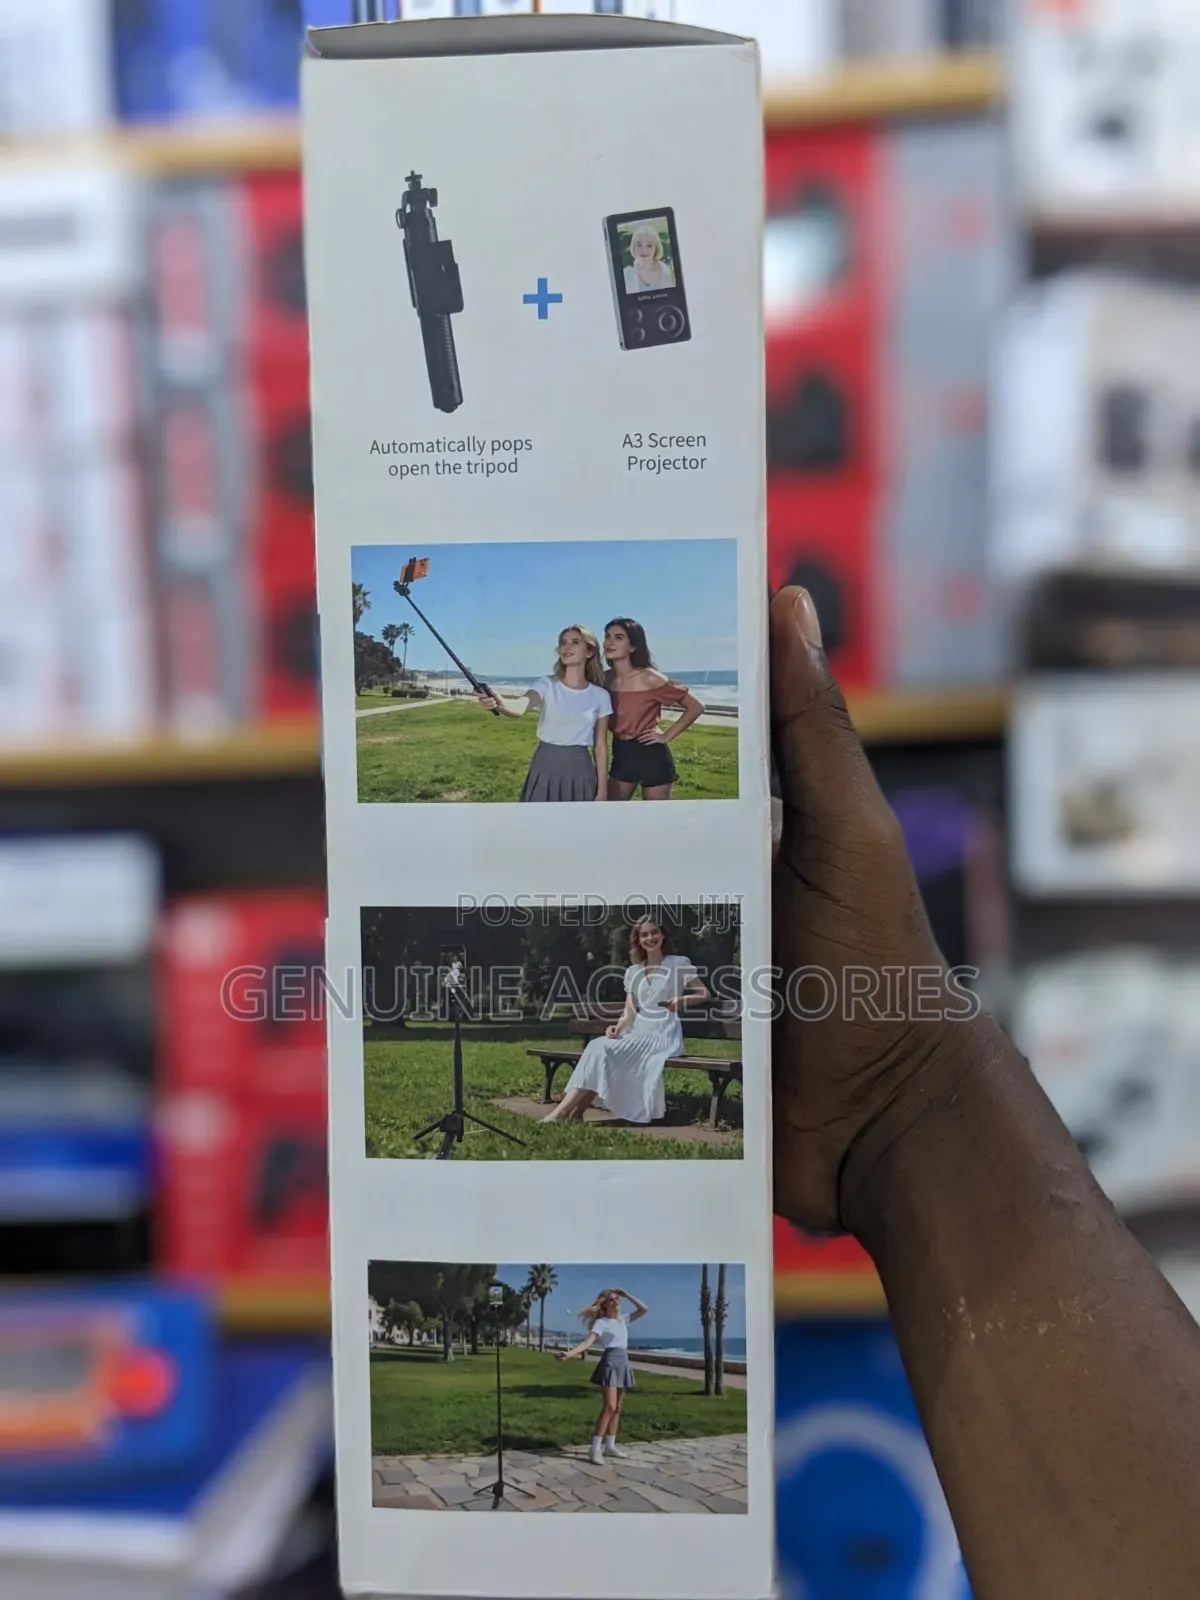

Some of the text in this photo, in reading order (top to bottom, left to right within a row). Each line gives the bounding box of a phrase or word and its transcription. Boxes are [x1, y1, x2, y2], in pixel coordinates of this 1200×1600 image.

[369, 436, 533, 456] Automatically pops
[622, 432, 707, 449] A3 Screen
[388, 457, 519, 480] open the tripod
[627, 454, 708, 475] Projector
